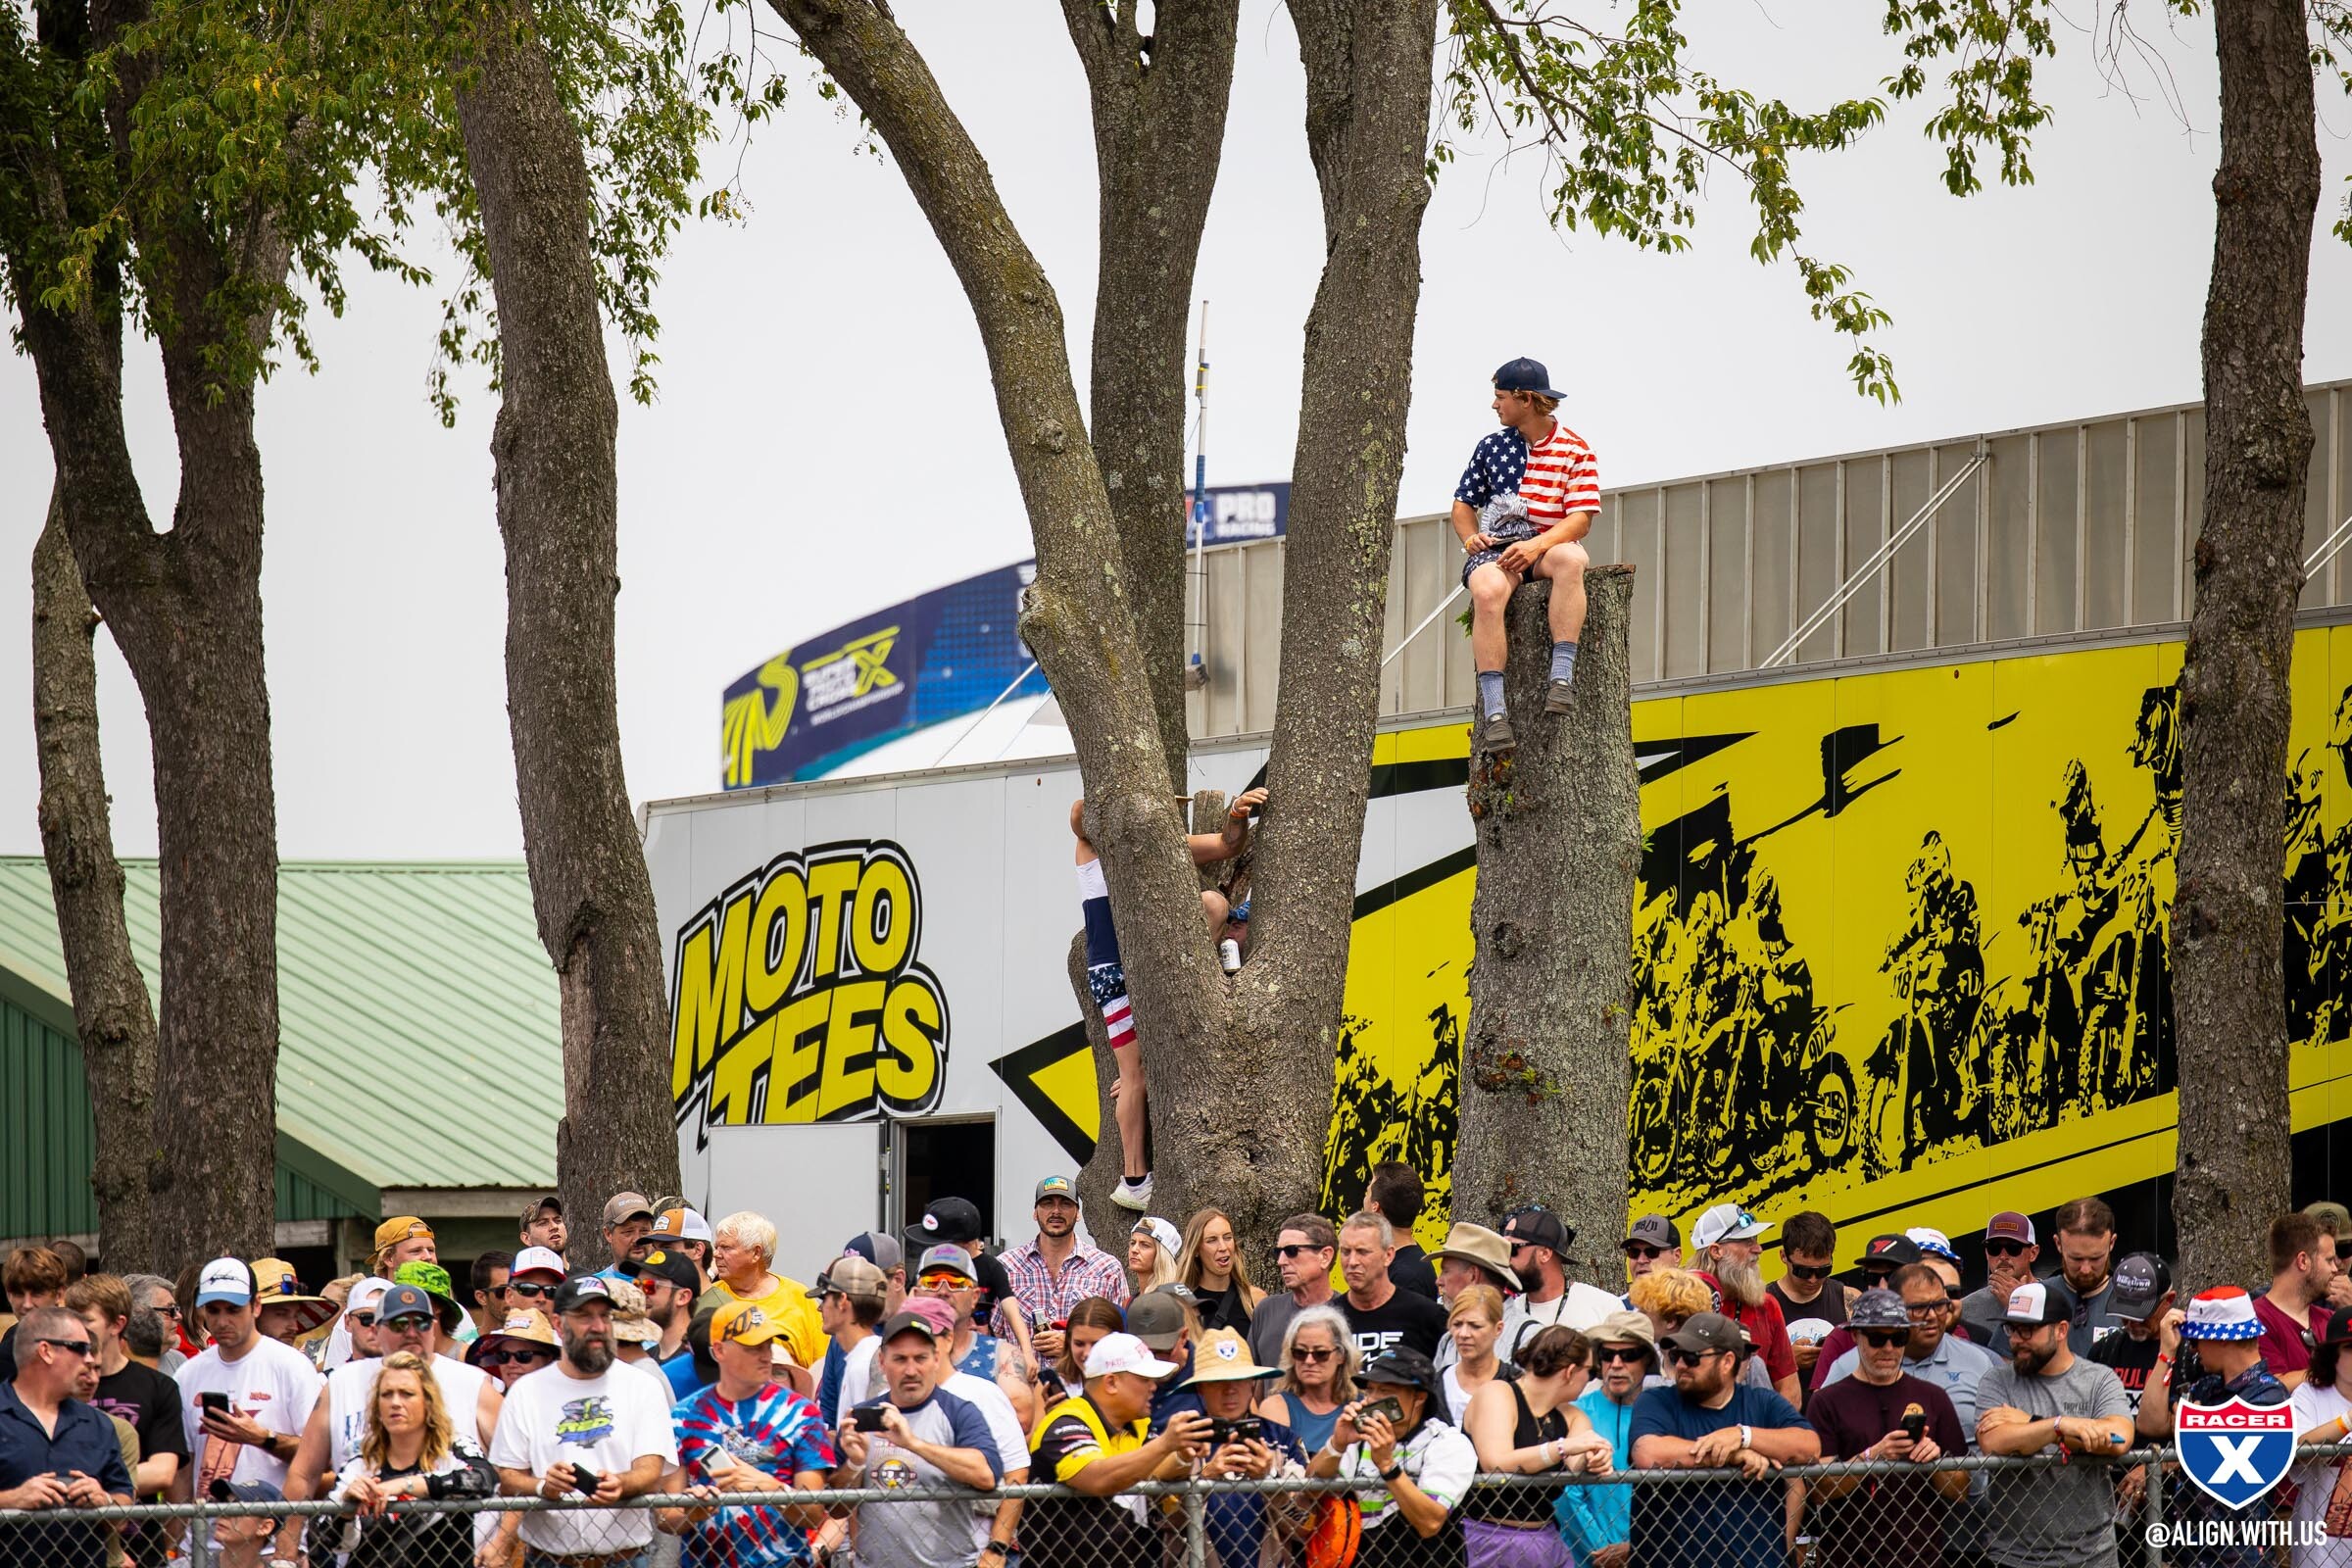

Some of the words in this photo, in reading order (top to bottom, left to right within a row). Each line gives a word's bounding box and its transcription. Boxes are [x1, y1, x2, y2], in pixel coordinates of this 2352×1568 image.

[1215, 492, 1276, 523] PRO
[671, 855, 913, 1102] MOTO
[710, 981, 940, 1124] TEES
